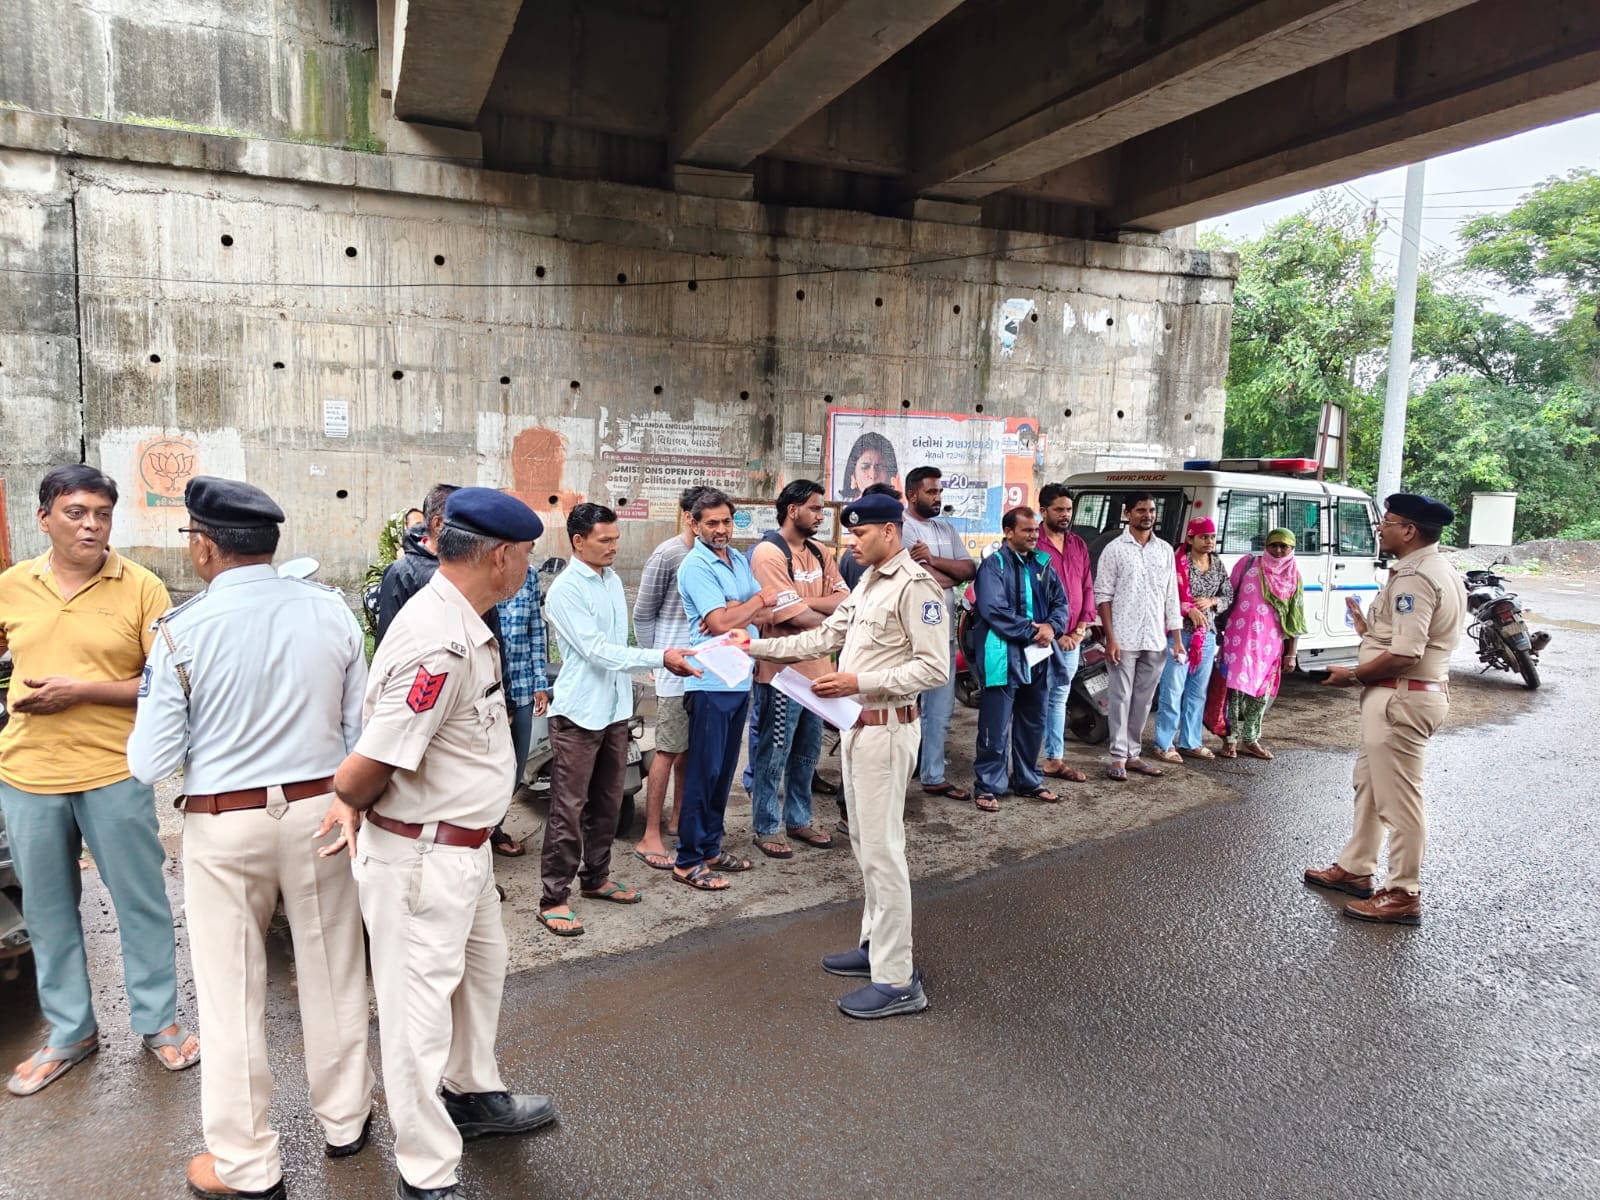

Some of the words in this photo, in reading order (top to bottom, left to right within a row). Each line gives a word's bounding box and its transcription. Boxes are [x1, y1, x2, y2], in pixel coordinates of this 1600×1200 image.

[912, 436, 942, 448] દાંતોમાં
[612, 466, 663, 474] DMISSONS
[664, 467, 687, 475] OPEN
[678, 476, 691, 484] for
[692, 478, 714, 487] Girls
[950, 474, 968, 489] 20
